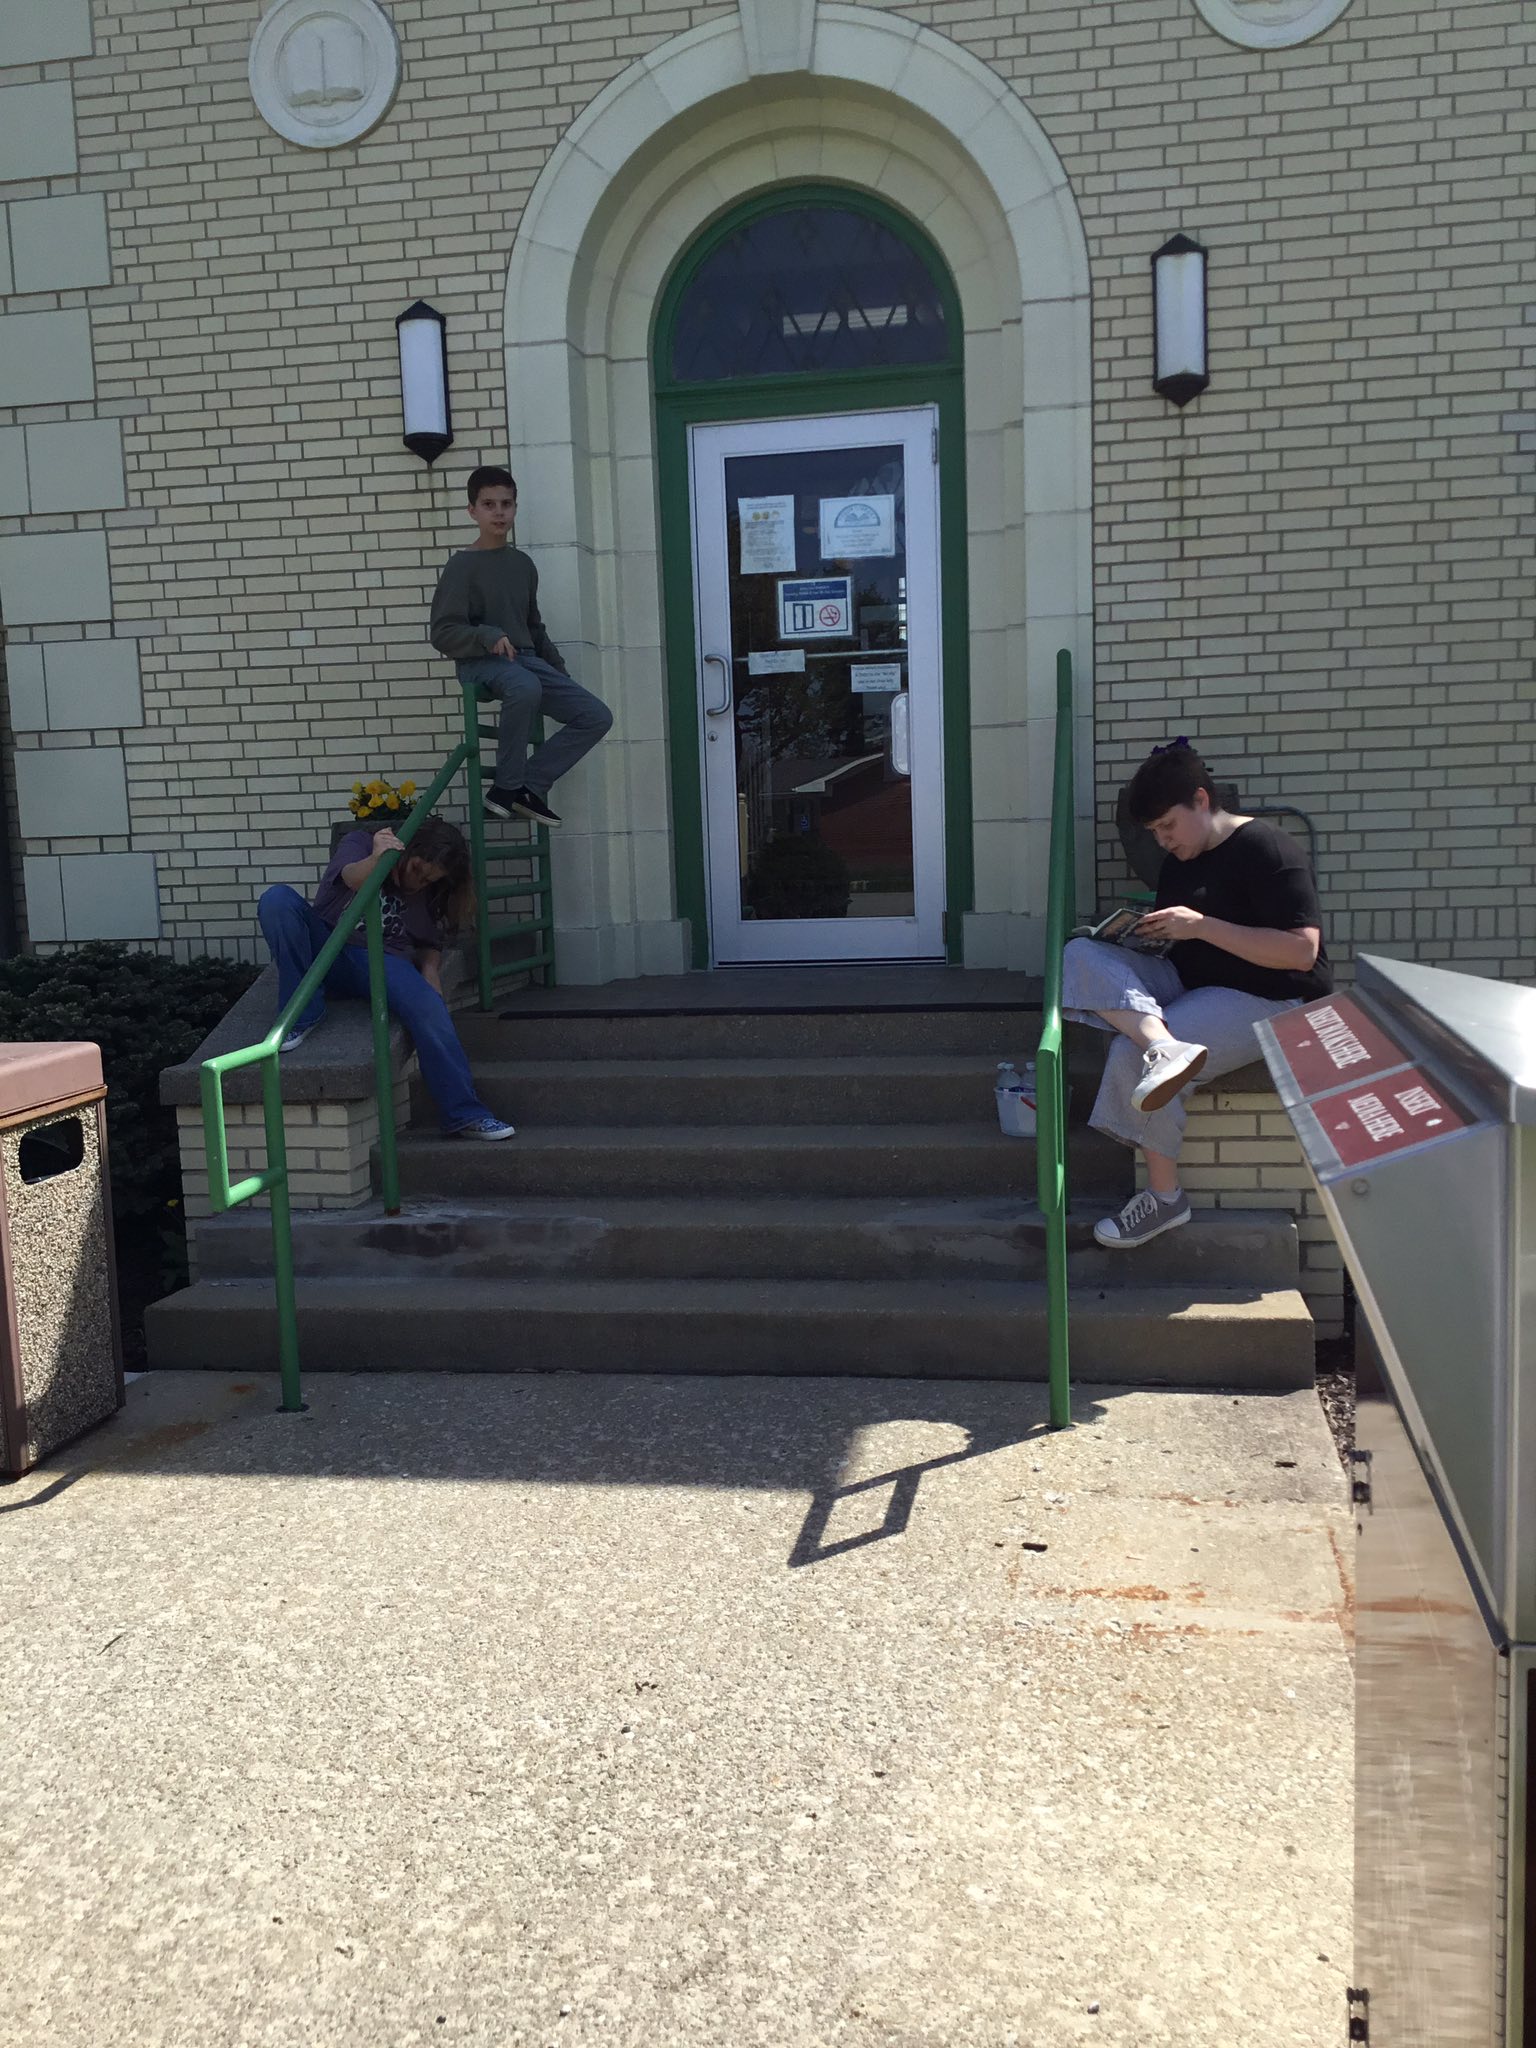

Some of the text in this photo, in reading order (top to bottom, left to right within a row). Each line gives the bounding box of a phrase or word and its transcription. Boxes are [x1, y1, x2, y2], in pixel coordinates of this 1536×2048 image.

[1305, 1005, 1372, 1070] INSERT BOOKS HERE
[1347, 1092, 1405, 1142] MEDIA HERE
[1393, 1085, 1442, 1116] INSERT
